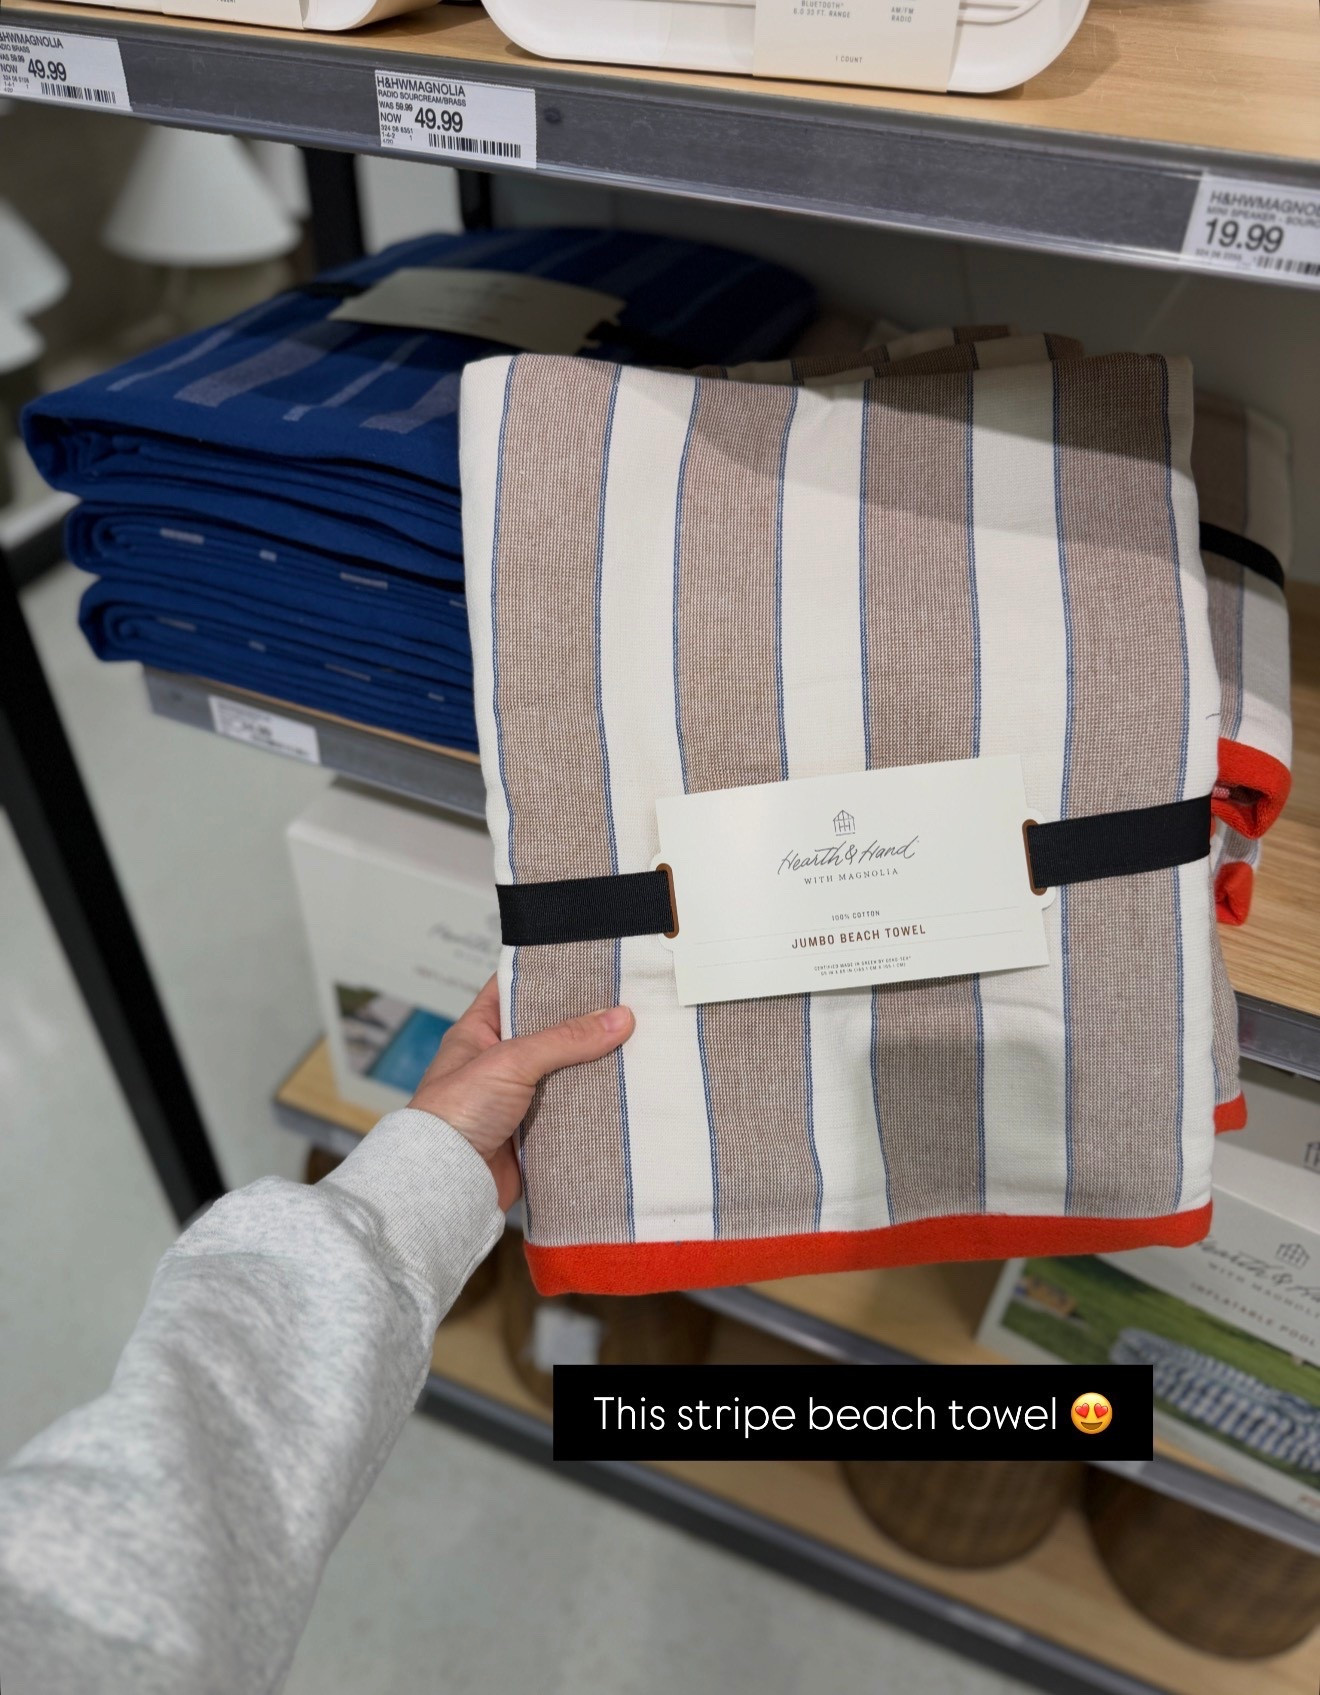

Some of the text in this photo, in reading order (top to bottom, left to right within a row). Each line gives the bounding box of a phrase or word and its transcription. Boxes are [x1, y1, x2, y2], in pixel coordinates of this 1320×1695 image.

[828, 10, 851, 18] RANGE
[891, 15, 912, 23] RADIO
[11, 45, 30, 53] BRASS
[840, 56, 863, 64] COUNT
[0, 58, 67, 82] NOW 49.99
[377, 75, 466, 97] H&HWMAGNOLIA
[378, 89, 467, 108] RADIO SOURCREAM/BRASS
[379, 100, 413, 112] WAS 59.99
[380, 107, 464, 133] NOW 49.99
[1206, 217, 1285, 254] 19.99
[777, 835, 919, 875] Hearth & Hand
[804, 867, 899, 885] WITH MAGNOLIA
[831, 910, 881, 922] 100% COTTON
[791, 924, 927, 950] JUMBO BEACH TOWEL
